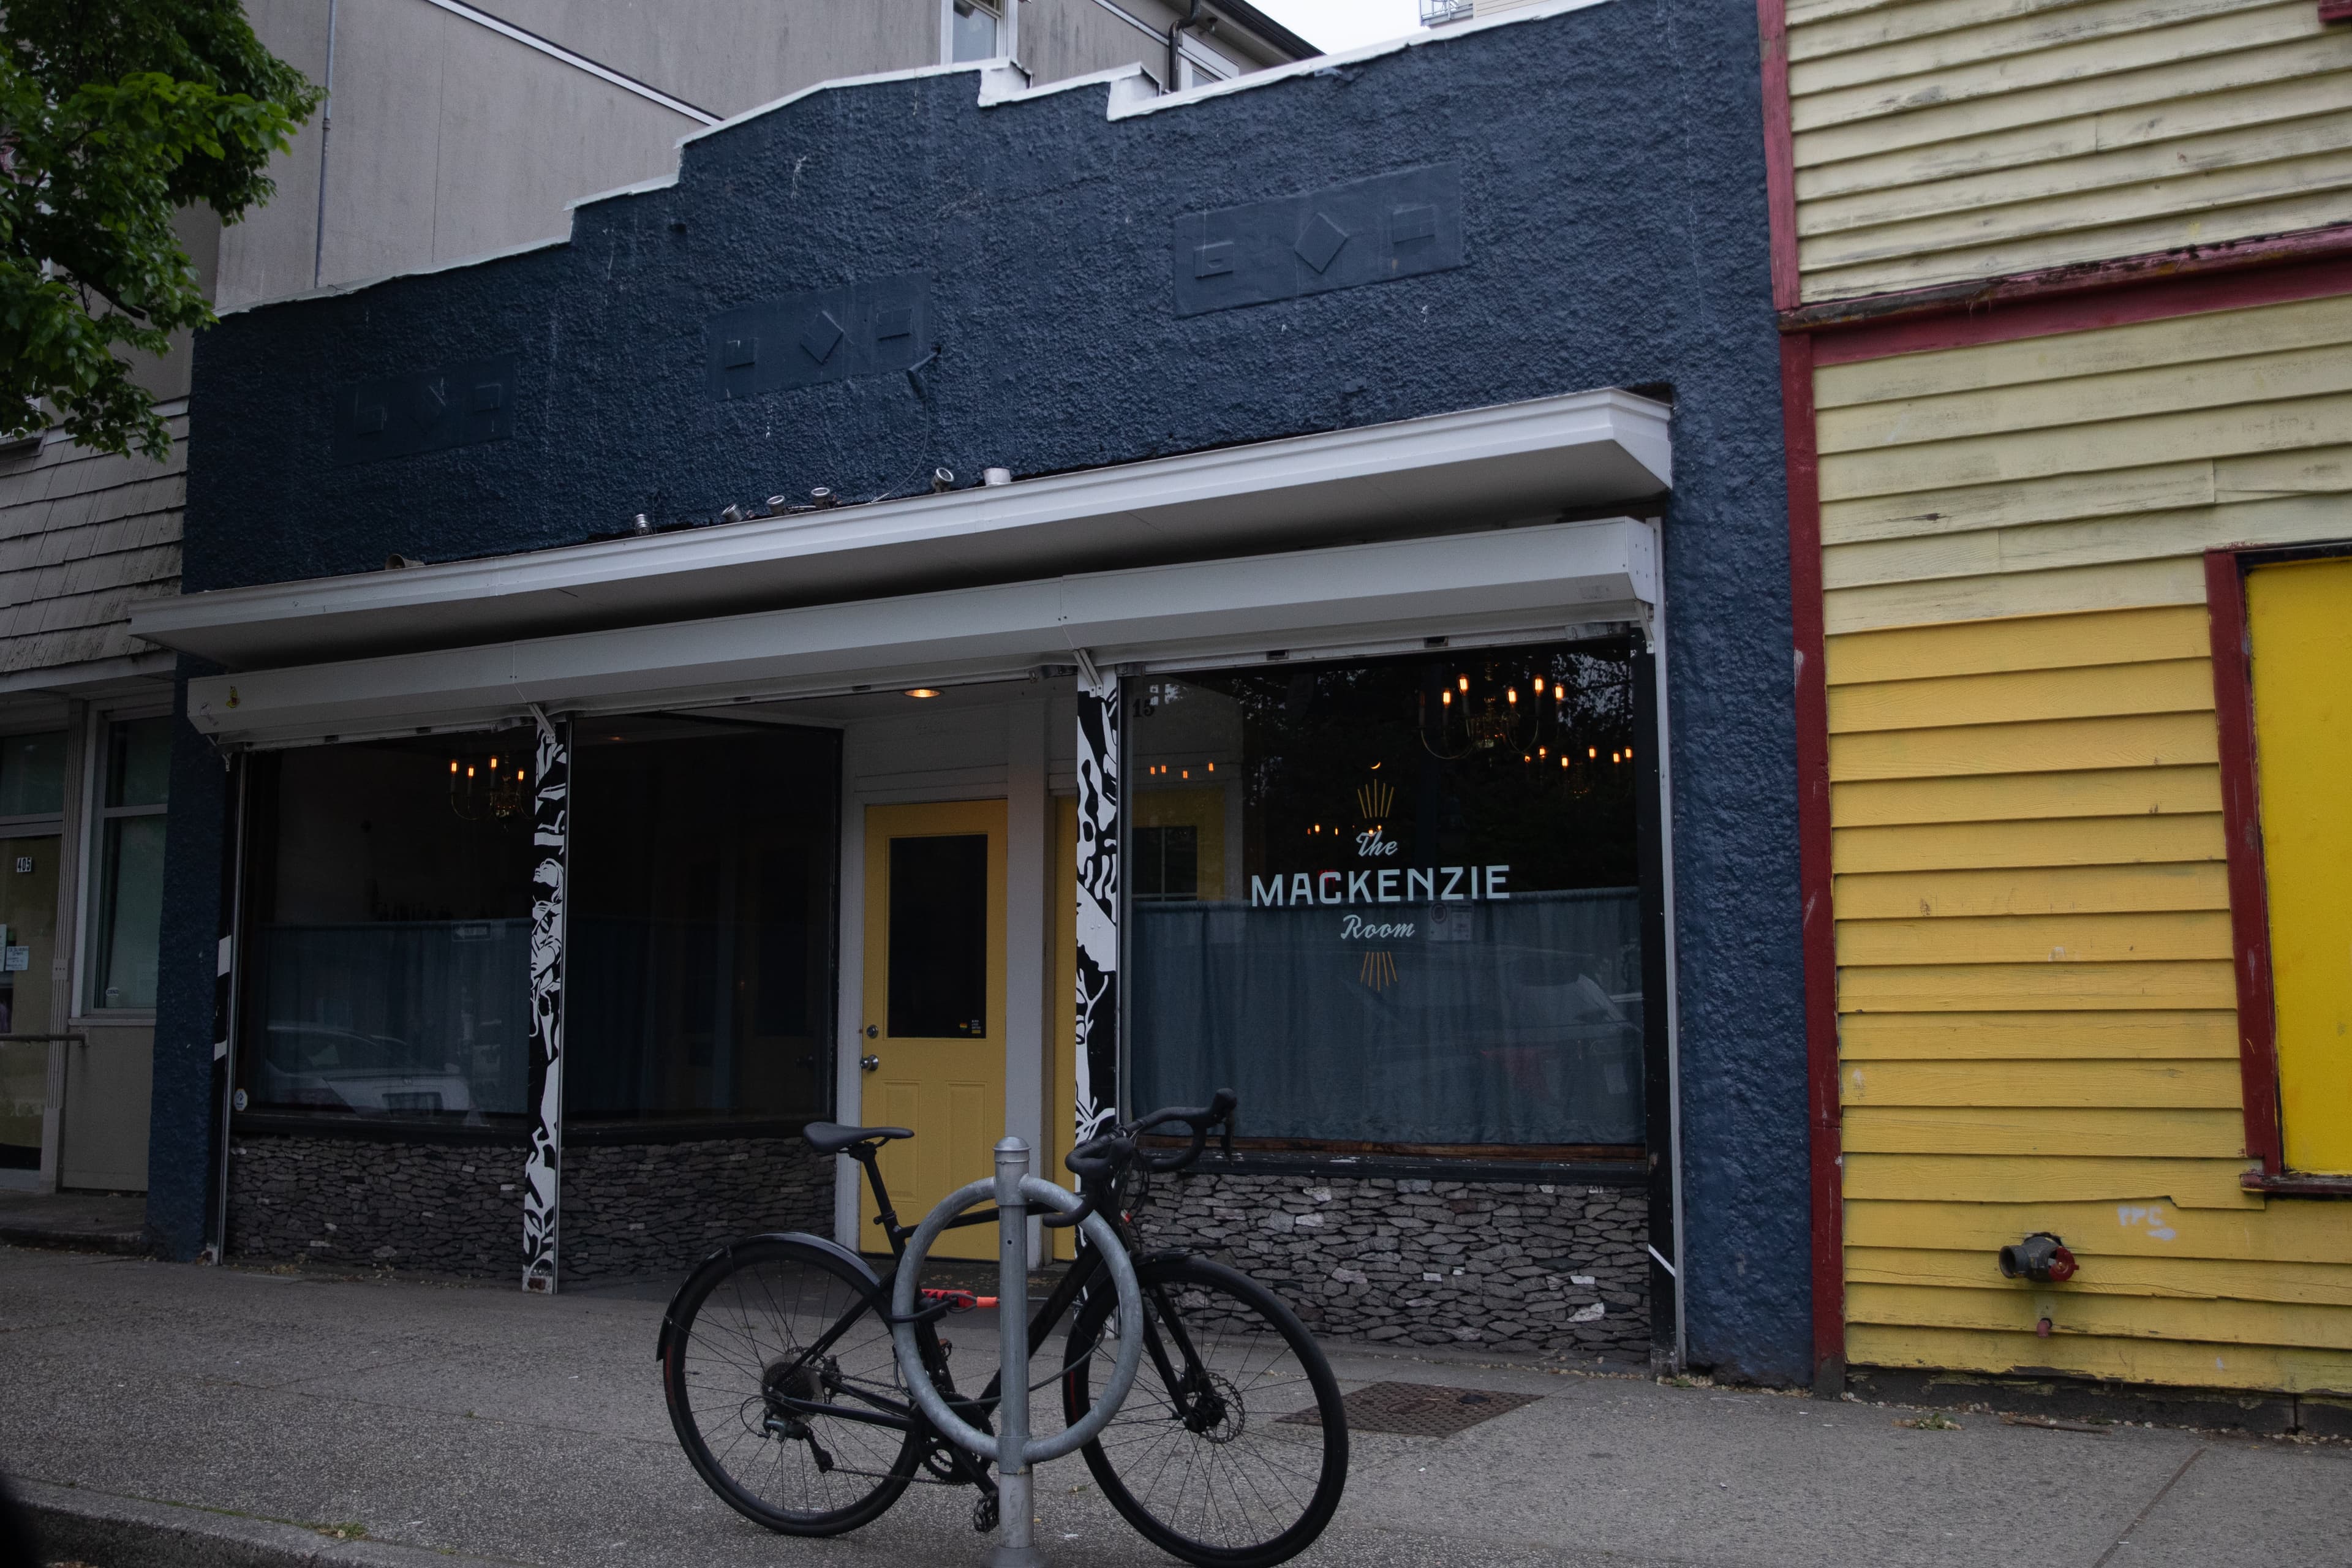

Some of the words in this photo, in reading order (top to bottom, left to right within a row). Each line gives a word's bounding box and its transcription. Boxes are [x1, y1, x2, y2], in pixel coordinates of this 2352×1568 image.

[1355, 830, 1398, 857] The
[18, 858, 31, 872] 405
[1251, 864, 1510, 907] MACKENZIE
[1340, 914, 1415, 940] Room
